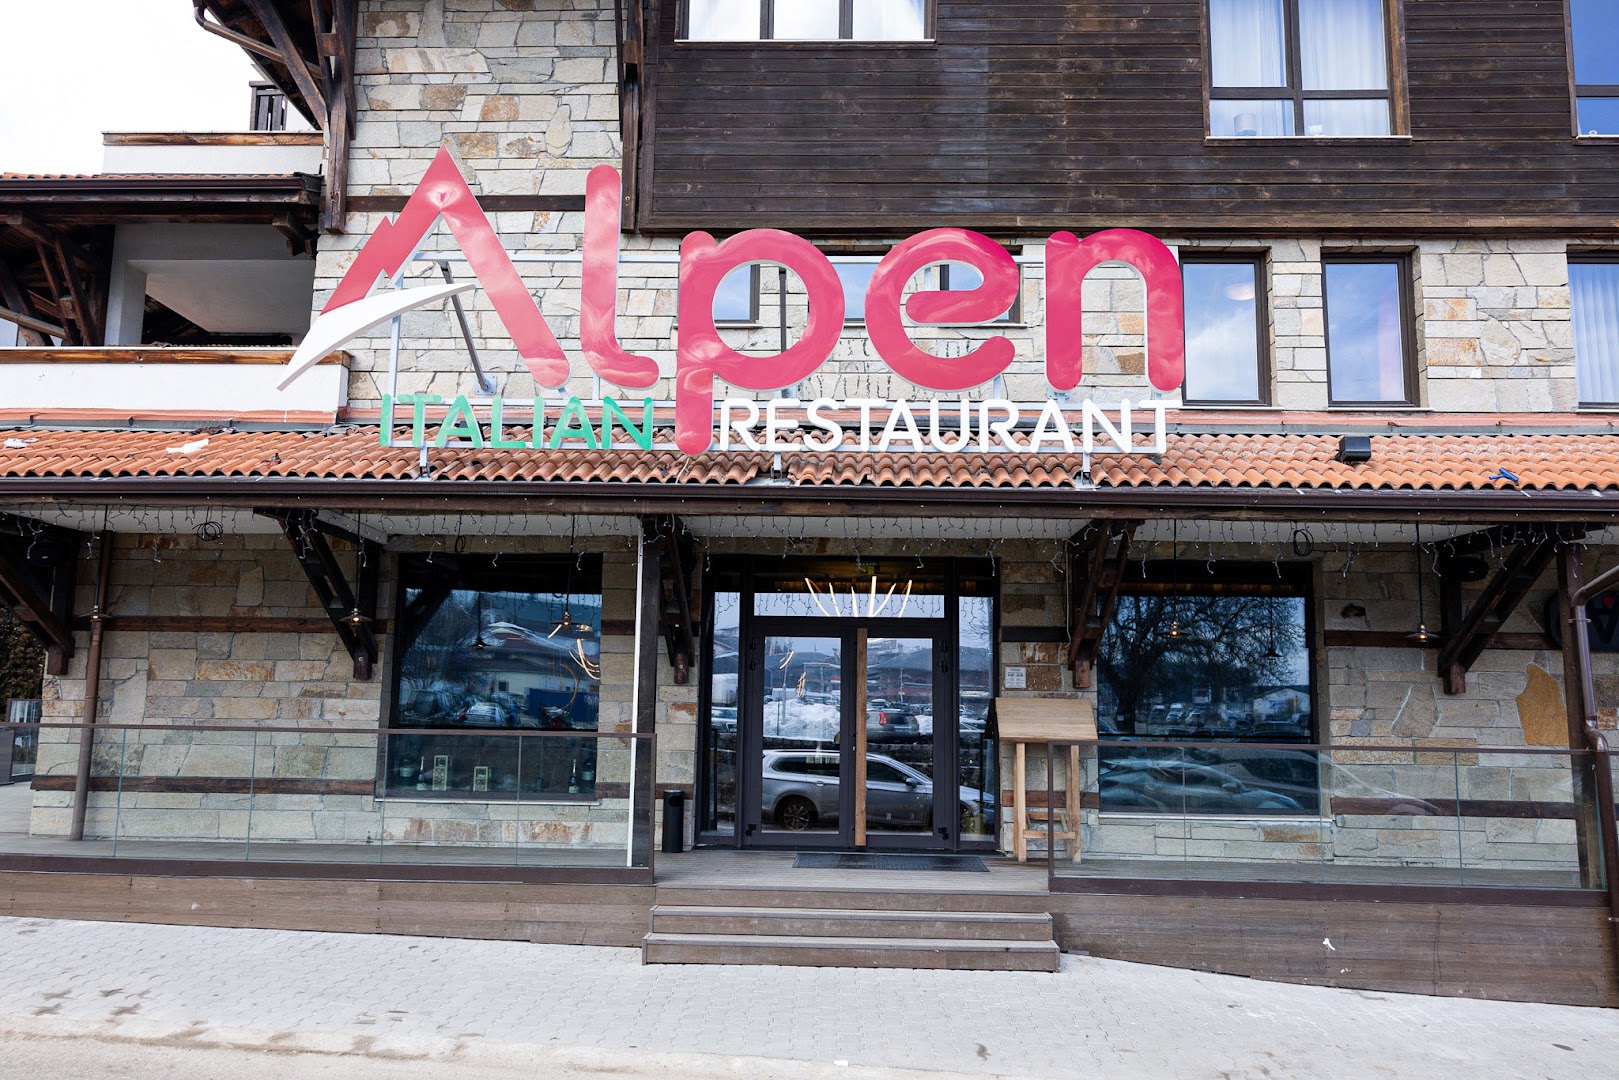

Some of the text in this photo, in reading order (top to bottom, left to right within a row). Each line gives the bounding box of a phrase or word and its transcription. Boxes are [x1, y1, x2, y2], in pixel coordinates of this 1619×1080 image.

[277, 144, 1184, 456] Alpen
[379, 393, 1183, 454] ITALIAN RESTAURANT
